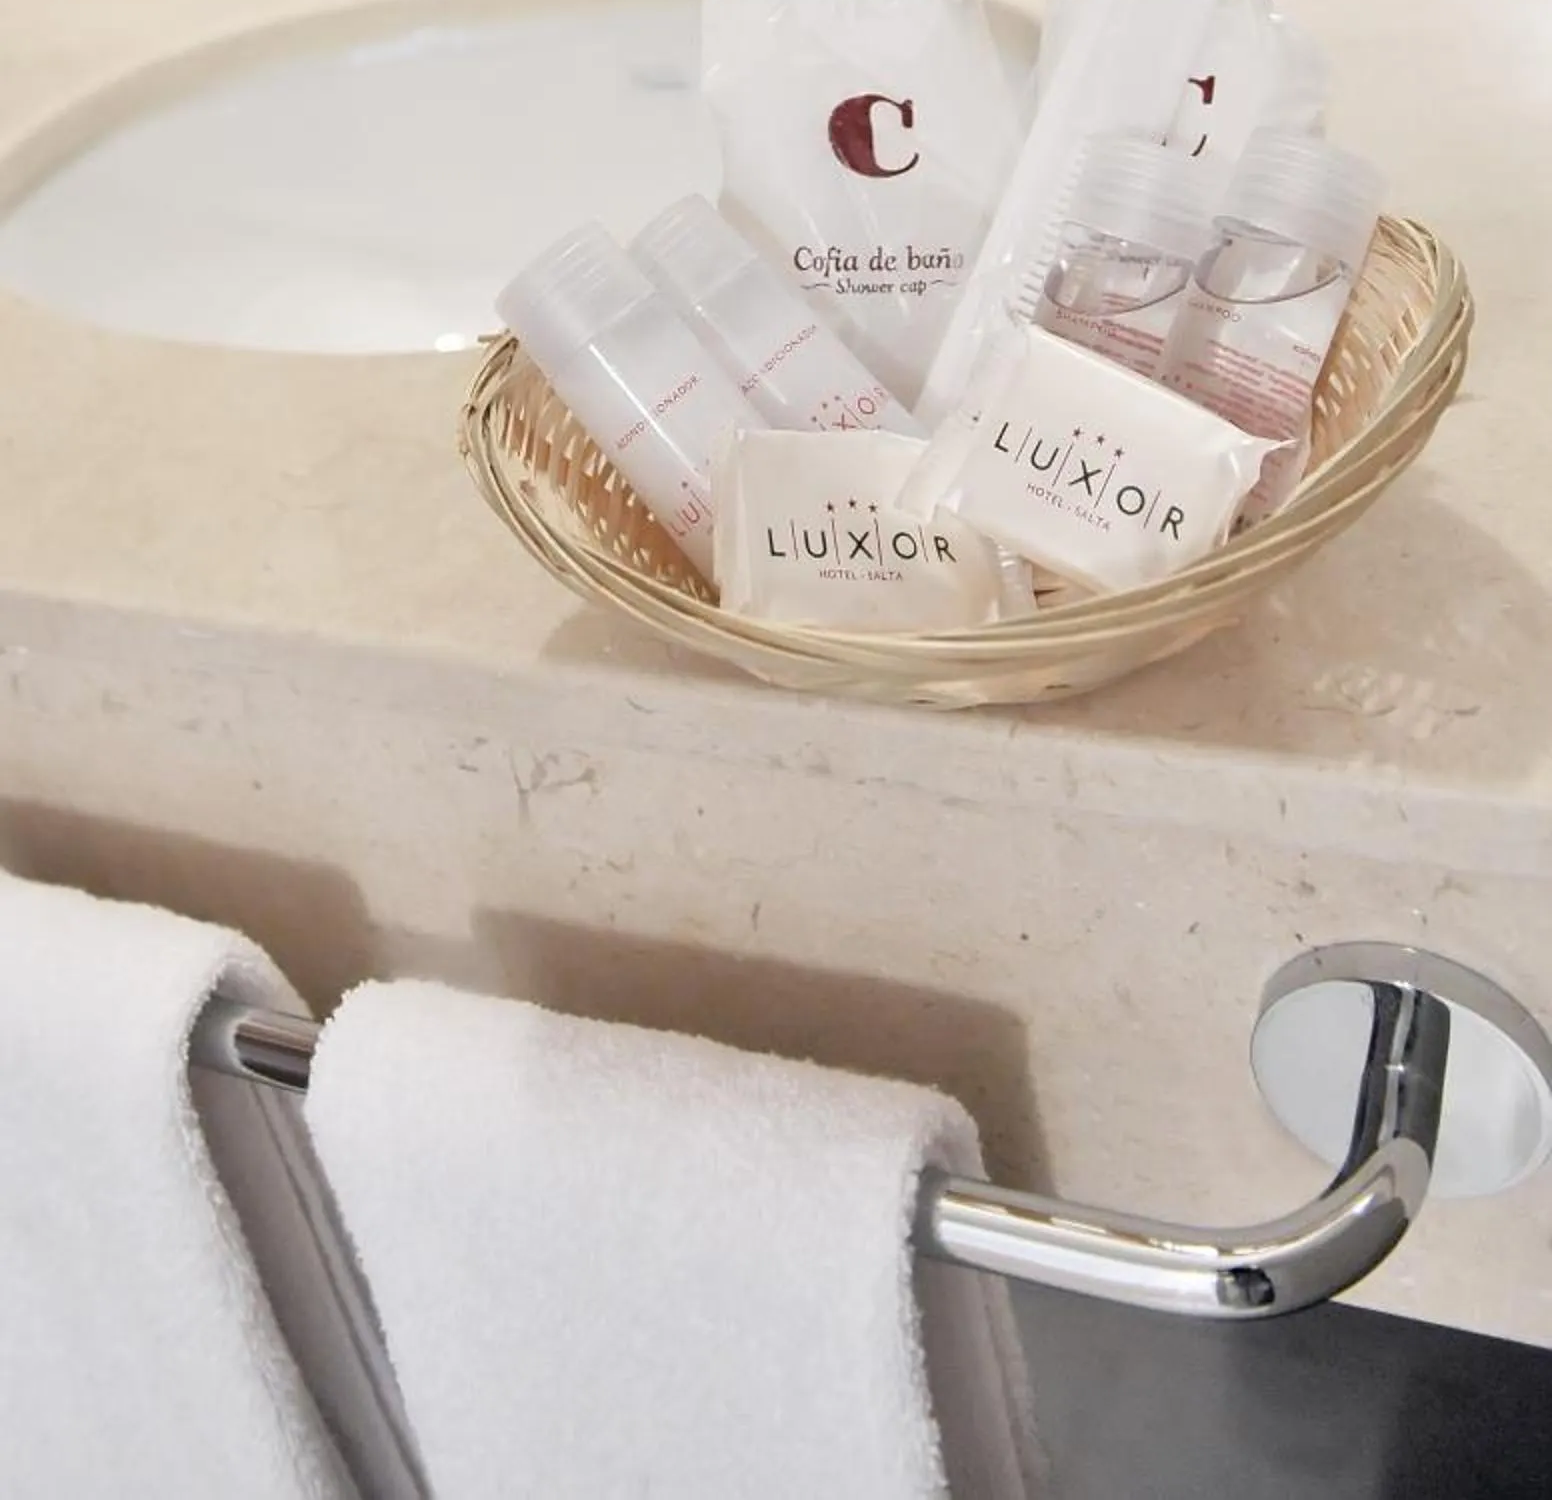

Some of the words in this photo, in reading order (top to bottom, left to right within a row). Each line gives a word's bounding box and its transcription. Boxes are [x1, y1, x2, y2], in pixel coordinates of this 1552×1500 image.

[827, 93, 919, 178] C
[793, 246, 859, 277] Cofia
[869, 245, 897, 272] de
[835, 279, 894, 296] Shower
[900, 279, 927, 297] cap
[993, 421, 1185, 541] LUXOR
[767, 527, 958, 563] LUXOR
